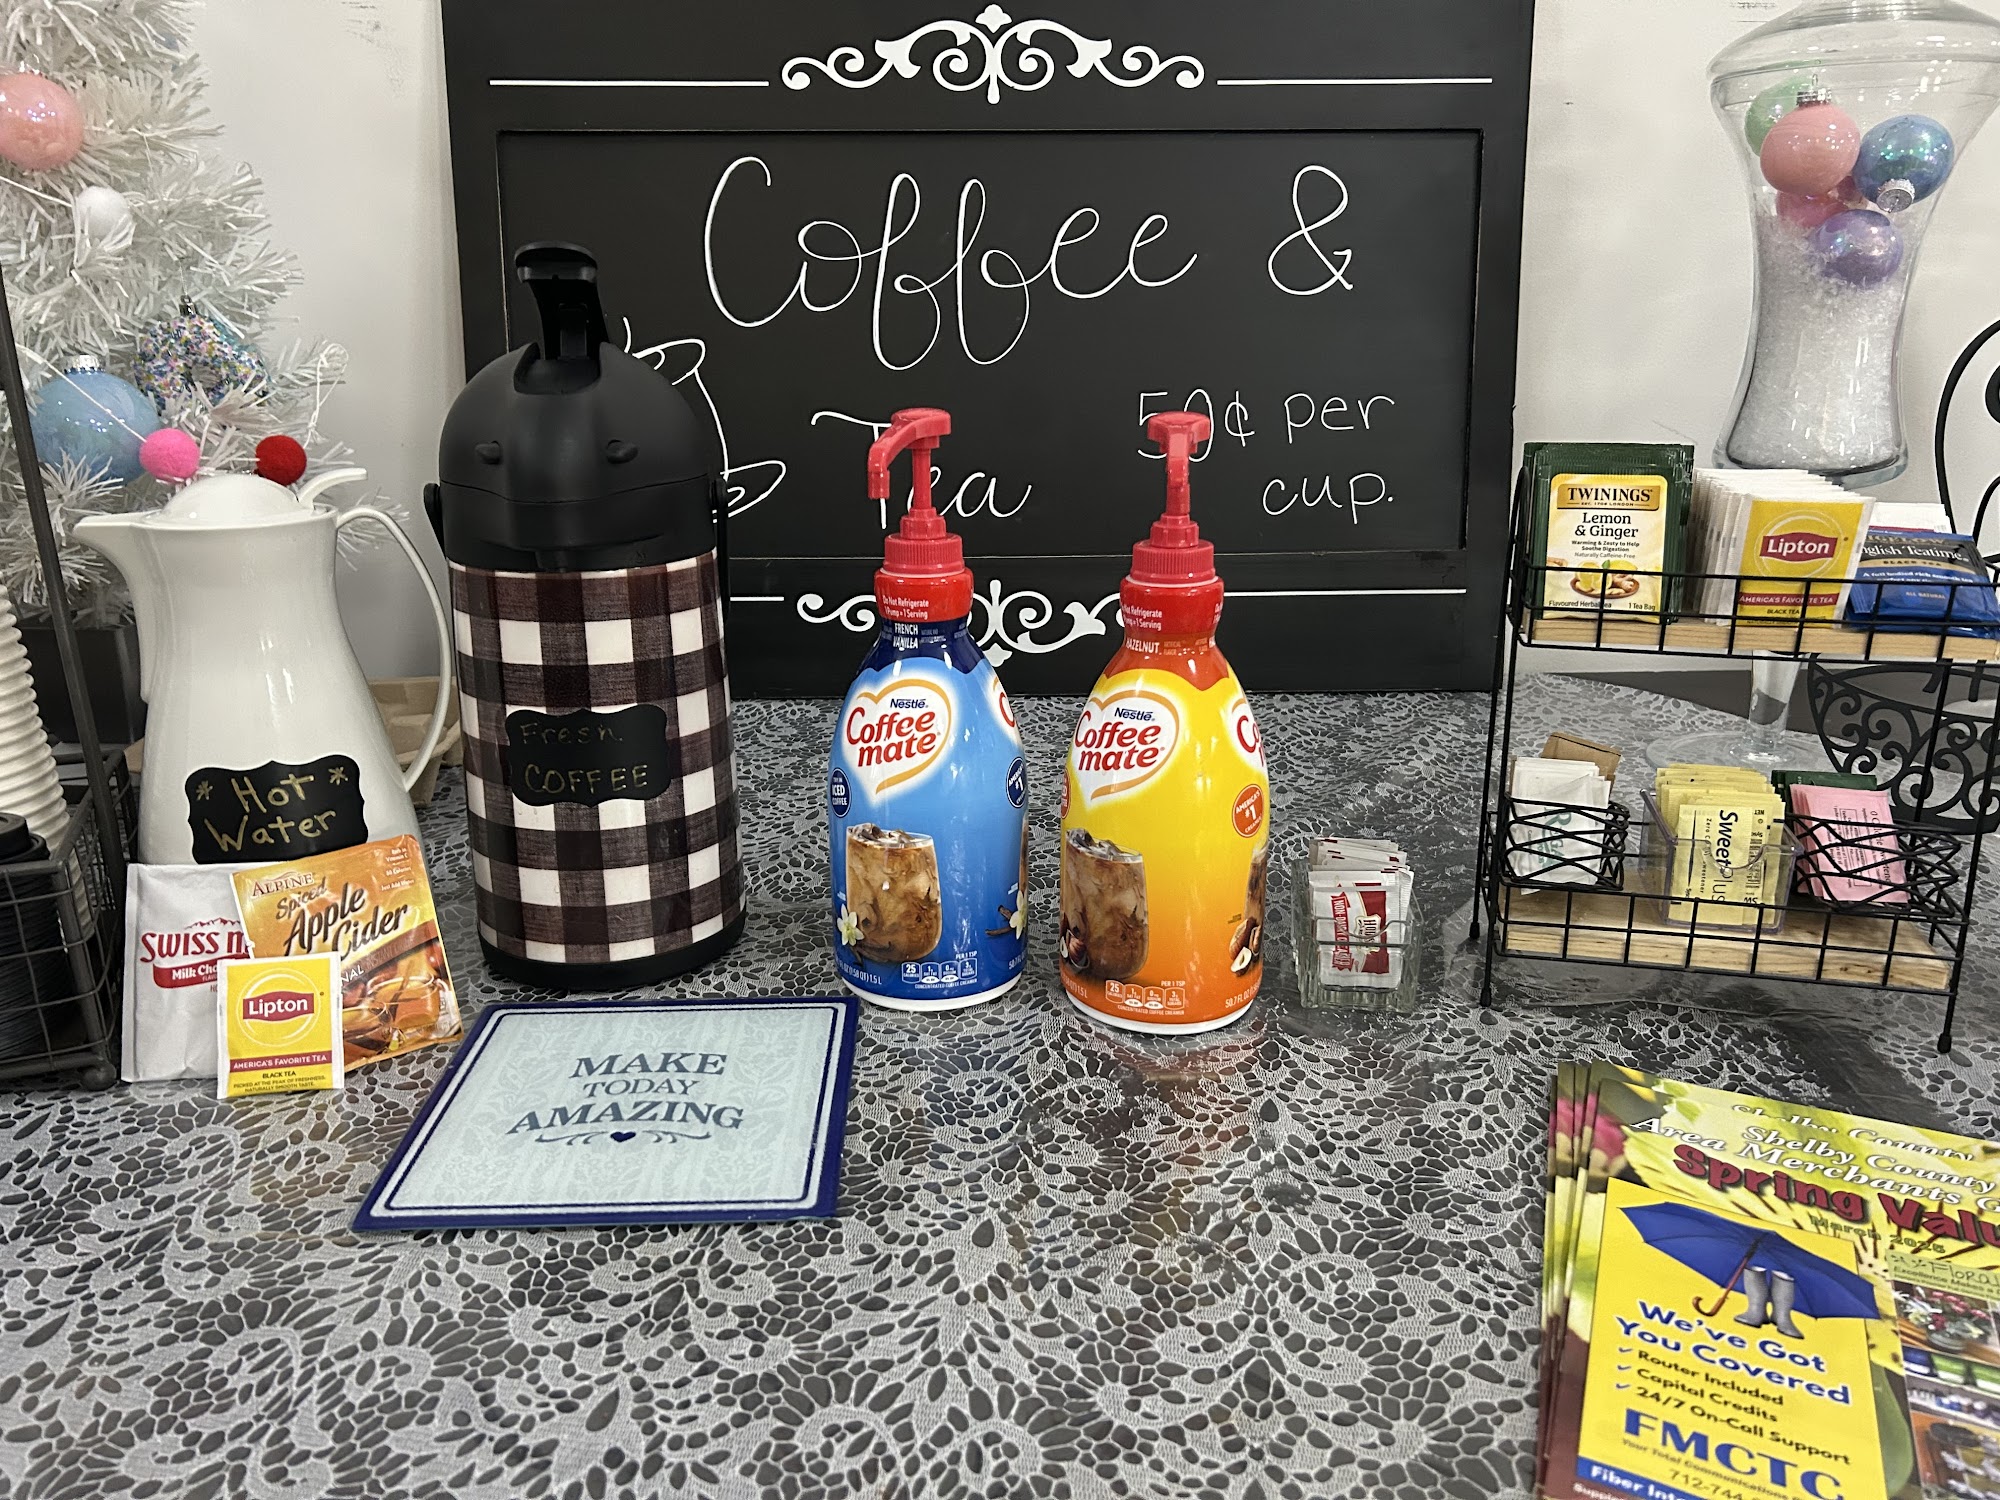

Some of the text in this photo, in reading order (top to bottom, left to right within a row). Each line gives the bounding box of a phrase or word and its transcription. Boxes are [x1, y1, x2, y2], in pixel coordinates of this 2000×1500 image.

[704, 156, 1354, 370] Coffee &
[1284, 393, 1395, 443] per
[1262, 473, 1394, 524] cup.
[1567, 487, 1651, 502] TWININGS
[1582, 512, 1631, 525] Lemon
[1574, 525, 1638, 540] & Ginger
[1767, 539, 1830, 556] Lipton
[1861, 544, 1962, 560] nglish Teatime
[897, 598, 929, 609] Refrigerate
[906, 609, 928, 620] Serving
[1130, 605, 1162, 618] Refrigerate
[894, 623, 918, 635] FRENCH
[1139, 618, 1162, 631] Serving
[893, 636, 919, 648] VANILLA
[1126, 637, 1160, 654] HAZELNUT
[846, 706, 936, 745] Coffee
[1074, 710, 1162, 749] Coffee
[857, 732, 937, 767] mate
[1078, 745, 1160, 771] mate
[525, 763, 648, 793] COFFEE
[832, 784, 845, 796] ICED
[231, 773, 315, 813] Hot
[832, 797, 848, 805] COFFEE
[1245, 804, 1257, 820] #1
[204, 810, 337, 851] Water
[252, 872, 315, 896] ALPINE
[275, 876, 328, 920] Spiced
[284, 882, 366, 956] Apple
[331, 904, 408, 961] Cider
[140, 931, 220, 963] SWISS
[172, 968, 197, 980] Milk
[905, 964, 916, 973] 25
[1110, 982, 1120, 993] 25
[248, 998, 308, 1017] Lipton
[233, 1054, 327, 1069] AMERICA'S FAVORITE TEA
[569, 1052, 727, 1079] MAKE
[583, 1078, 700, 1098] TODAY
[505, 1101, 744, 1134] AMAZING
[1631, 1117, 1726, 1151] Area
[1735, 1144, 1960, 1205] Merchants
[1742, 1126, 1995, 1195] Shelby County
[1673, 1144, 1868, 1222] Spring
[1810, 1215, 1882, 1241] March
[1638, 1300, 1826, 1373] We've Got
[1615, 1316, 1851, 1405] You Covered
[1638, 1350, 1784, 1406] Router Included
[1637, 1368, 1778, 1422] Capital Credits
[1635, 1386, 1851, 1466] 24/7 On-Call Support
[1622, 1439, 1650, 1454] Your
[1652, 1447, 1681, 1464] Total
[1624, 1408, 1844, 1500] FMCTC
[1590, 1465, 1644, 1492] Fiber
